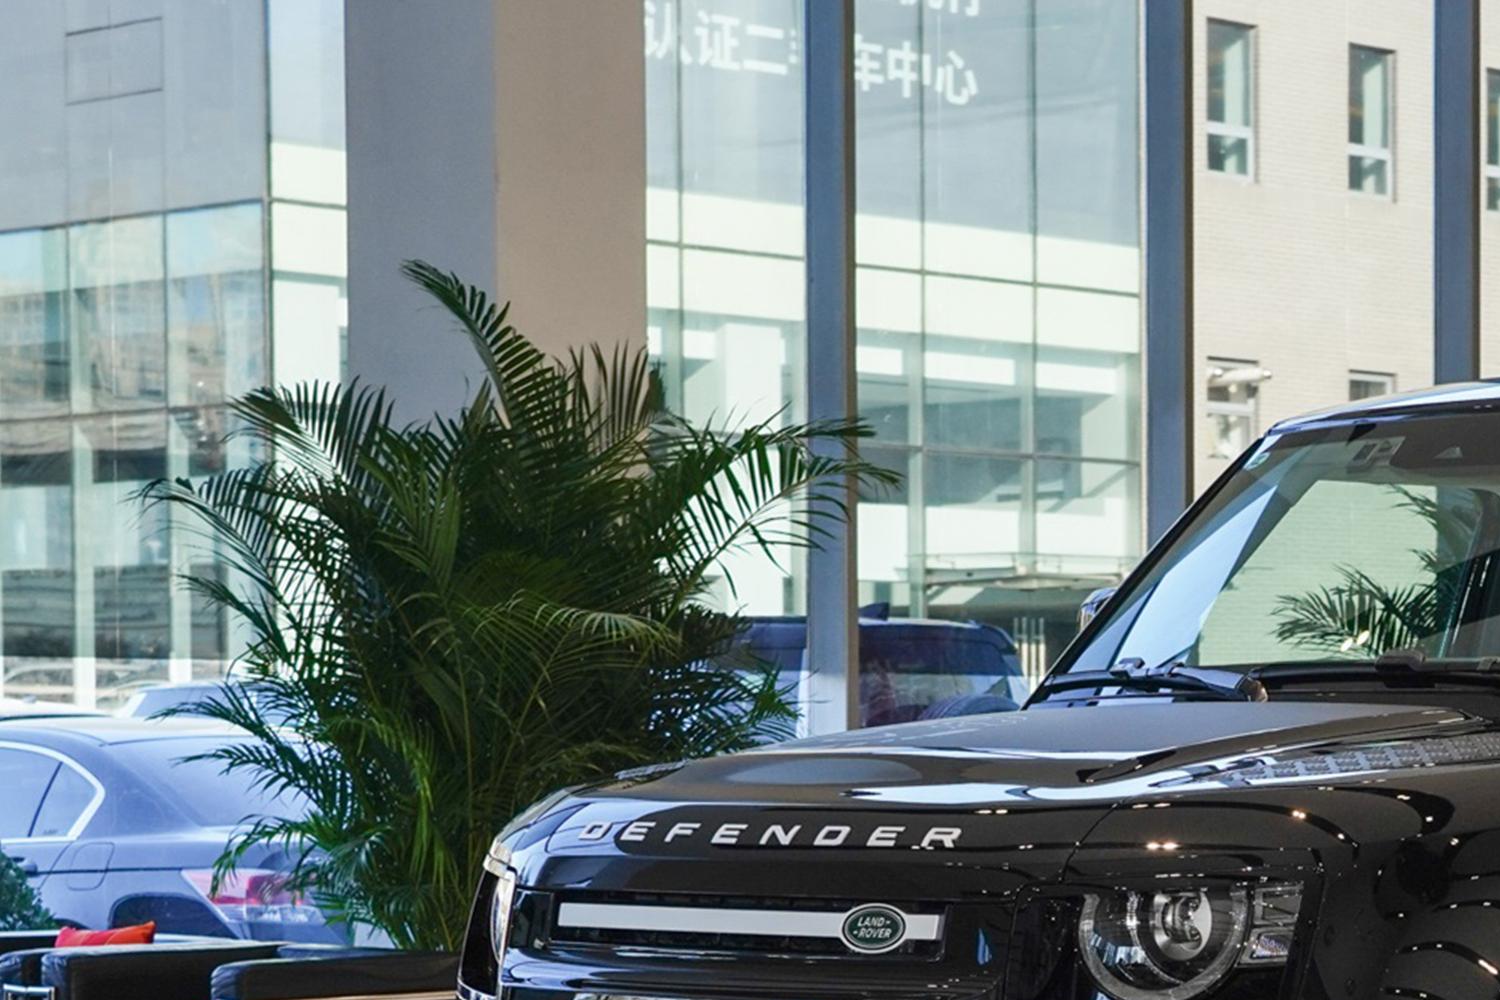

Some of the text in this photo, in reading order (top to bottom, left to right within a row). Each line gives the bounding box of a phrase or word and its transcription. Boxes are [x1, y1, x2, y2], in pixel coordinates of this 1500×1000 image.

[644, 0, 979, 105] 认证二车中心
[578, 821, 962, 849] DEFENDER
[857, 916, 885, 927] LAND
[857, 928, 892, 938] ROVER
